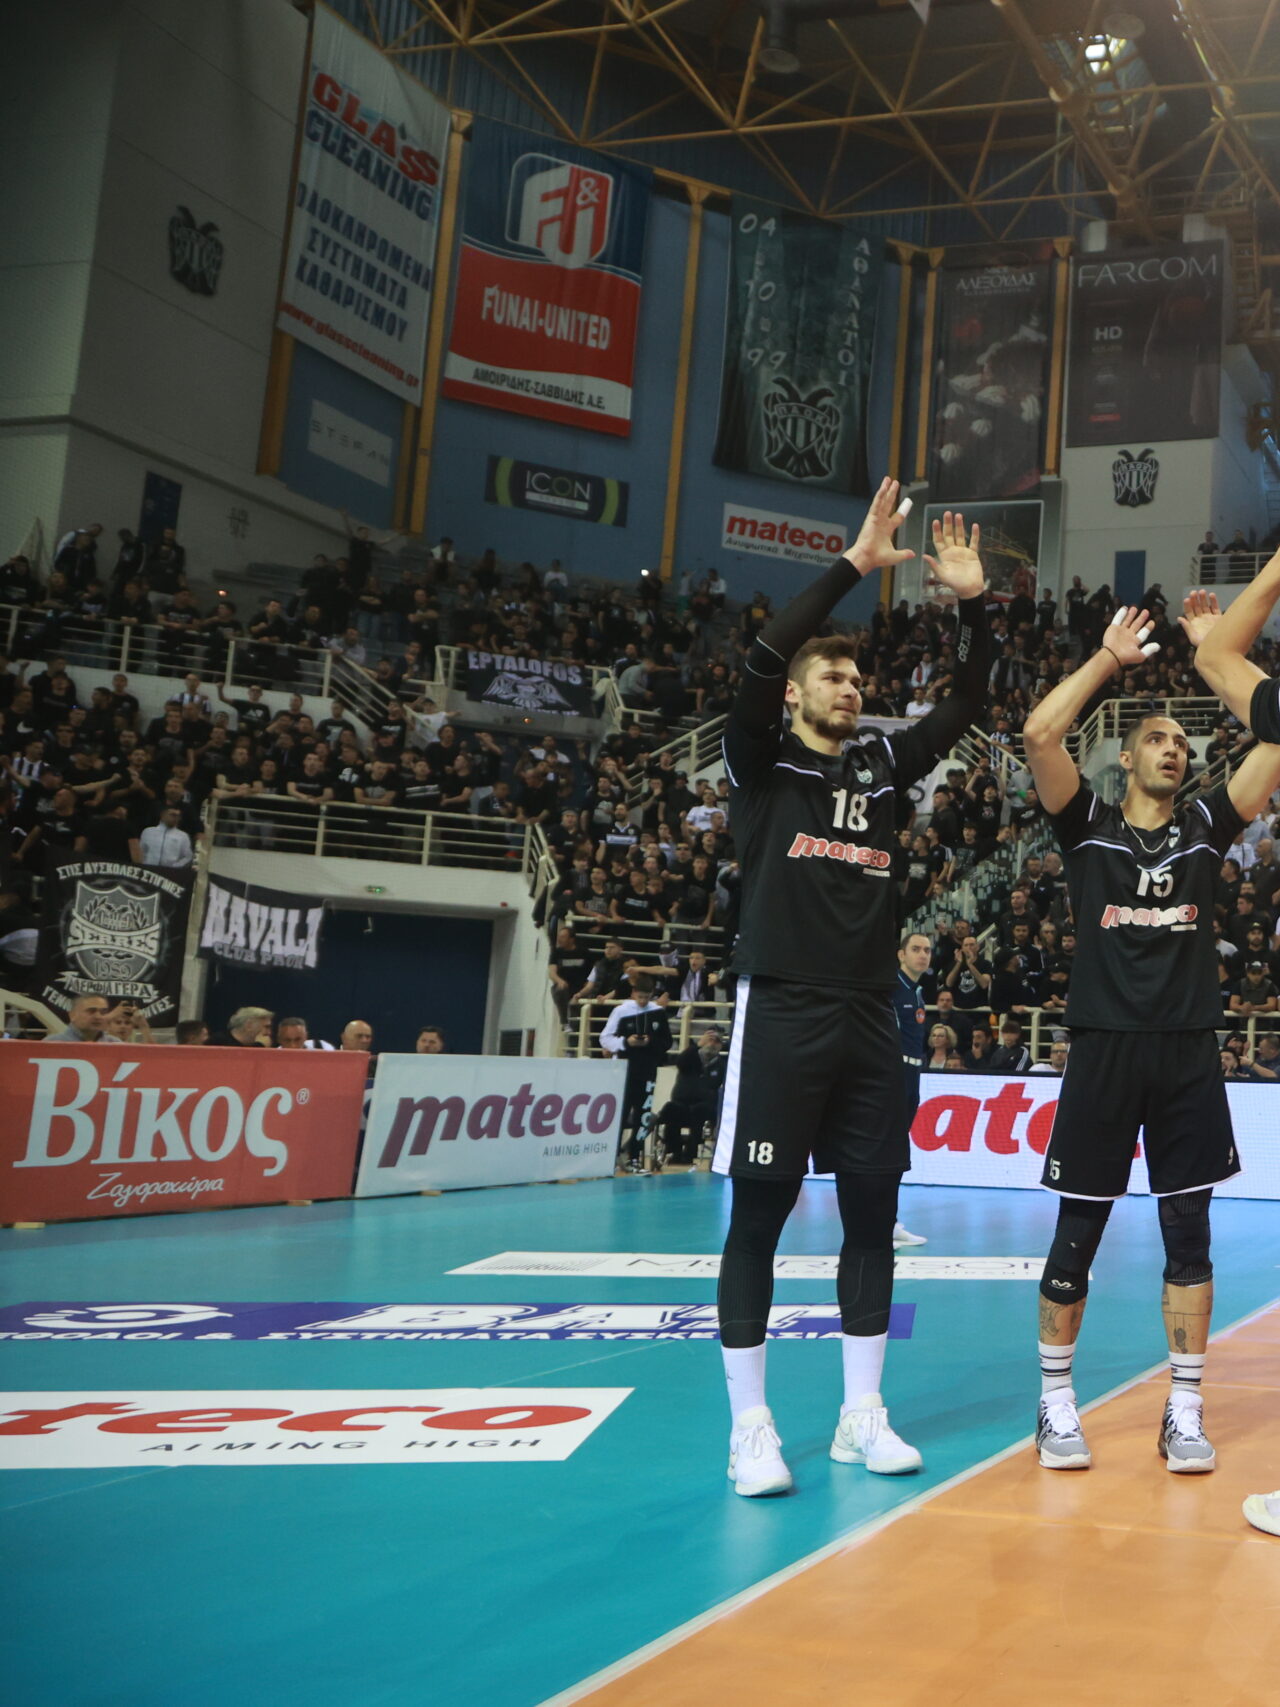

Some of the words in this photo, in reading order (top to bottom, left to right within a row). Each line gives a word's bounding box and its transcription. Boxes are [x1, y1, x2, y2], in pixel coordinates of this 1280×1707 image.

[313, 72, 440, 186] GLASS
[305, 109, 434, 221] CLEANING
[740, 213, 776, 237] 04
[307, 226, 408, 311] ΣΥΣΤΗΜΑΤΑ
[1078, 254, 1217, 288] FARCOM
[746, 280, 776, 301] 10
[1095, 326, 1123, 341] HD
[747, 348, 786, 370] 99
[525, 470, 591, 501] ICON
[727, 515, 844, 553] mateco
[467, 651, 582, 685] EPTALOFOS
[832, 788, 869, 832] 18
[1136, 864, 1174, 898] 15
[68, 917, 160, 958] SERRES
[200, 882, 322, 968] KAVALA
[13, 1057, 293, 1177] Βίκος
[377, 1083, 618, 1169] mateco
[543, 1145, 581, 1158] AIMING
[583, 1142, 609, 1155] HIGH
[747, 1139, 774, 1165] 18
[138, 1440, 371, 1453] AIMING
[403, 1438, 544, 1449] HIGH
